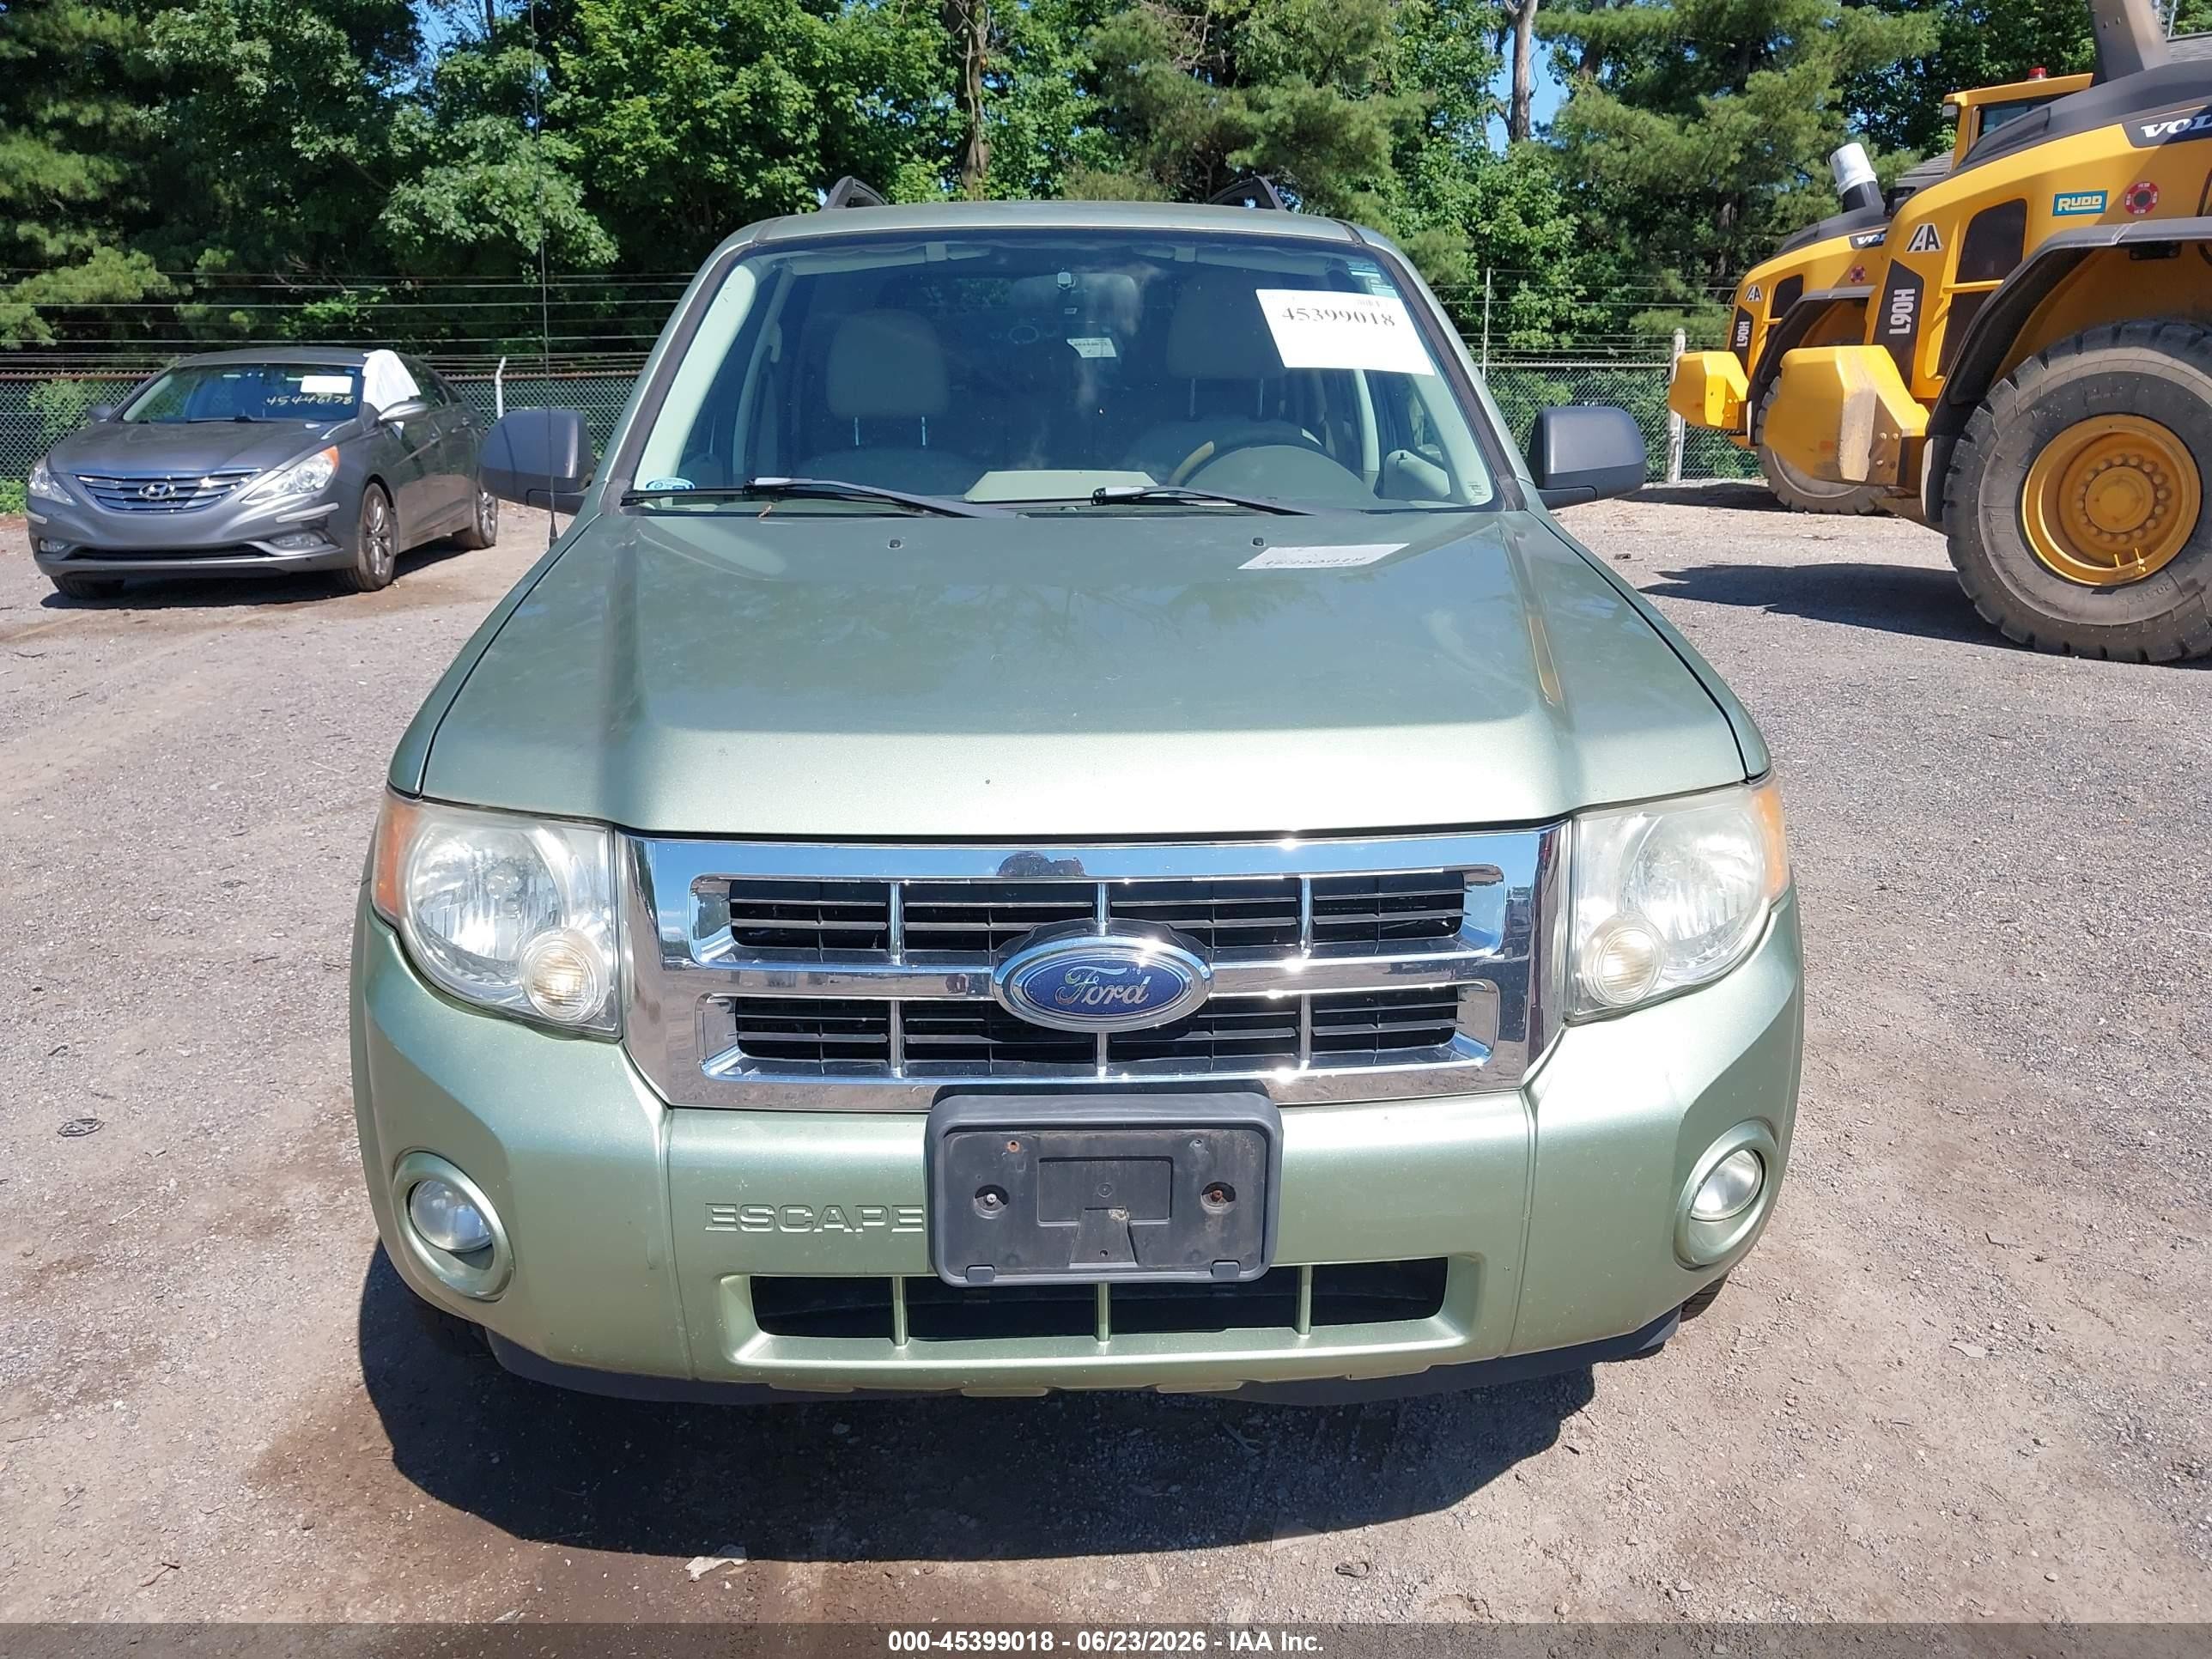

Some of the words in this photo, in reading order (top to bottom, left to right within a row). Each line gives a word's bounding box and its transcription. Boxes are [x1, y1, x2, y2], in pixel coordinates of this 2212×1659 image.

[2057, 195, 2103, 211] RUDD
[1282, 307, 1395, 326] 45399018
[1889, 289, 1916, 334] L90H
[1736, 321, 1750, 347] L90H
[1054, 965, 1152, 1006] Ford
[704, 1203, 924, 1232] ESCAPE
